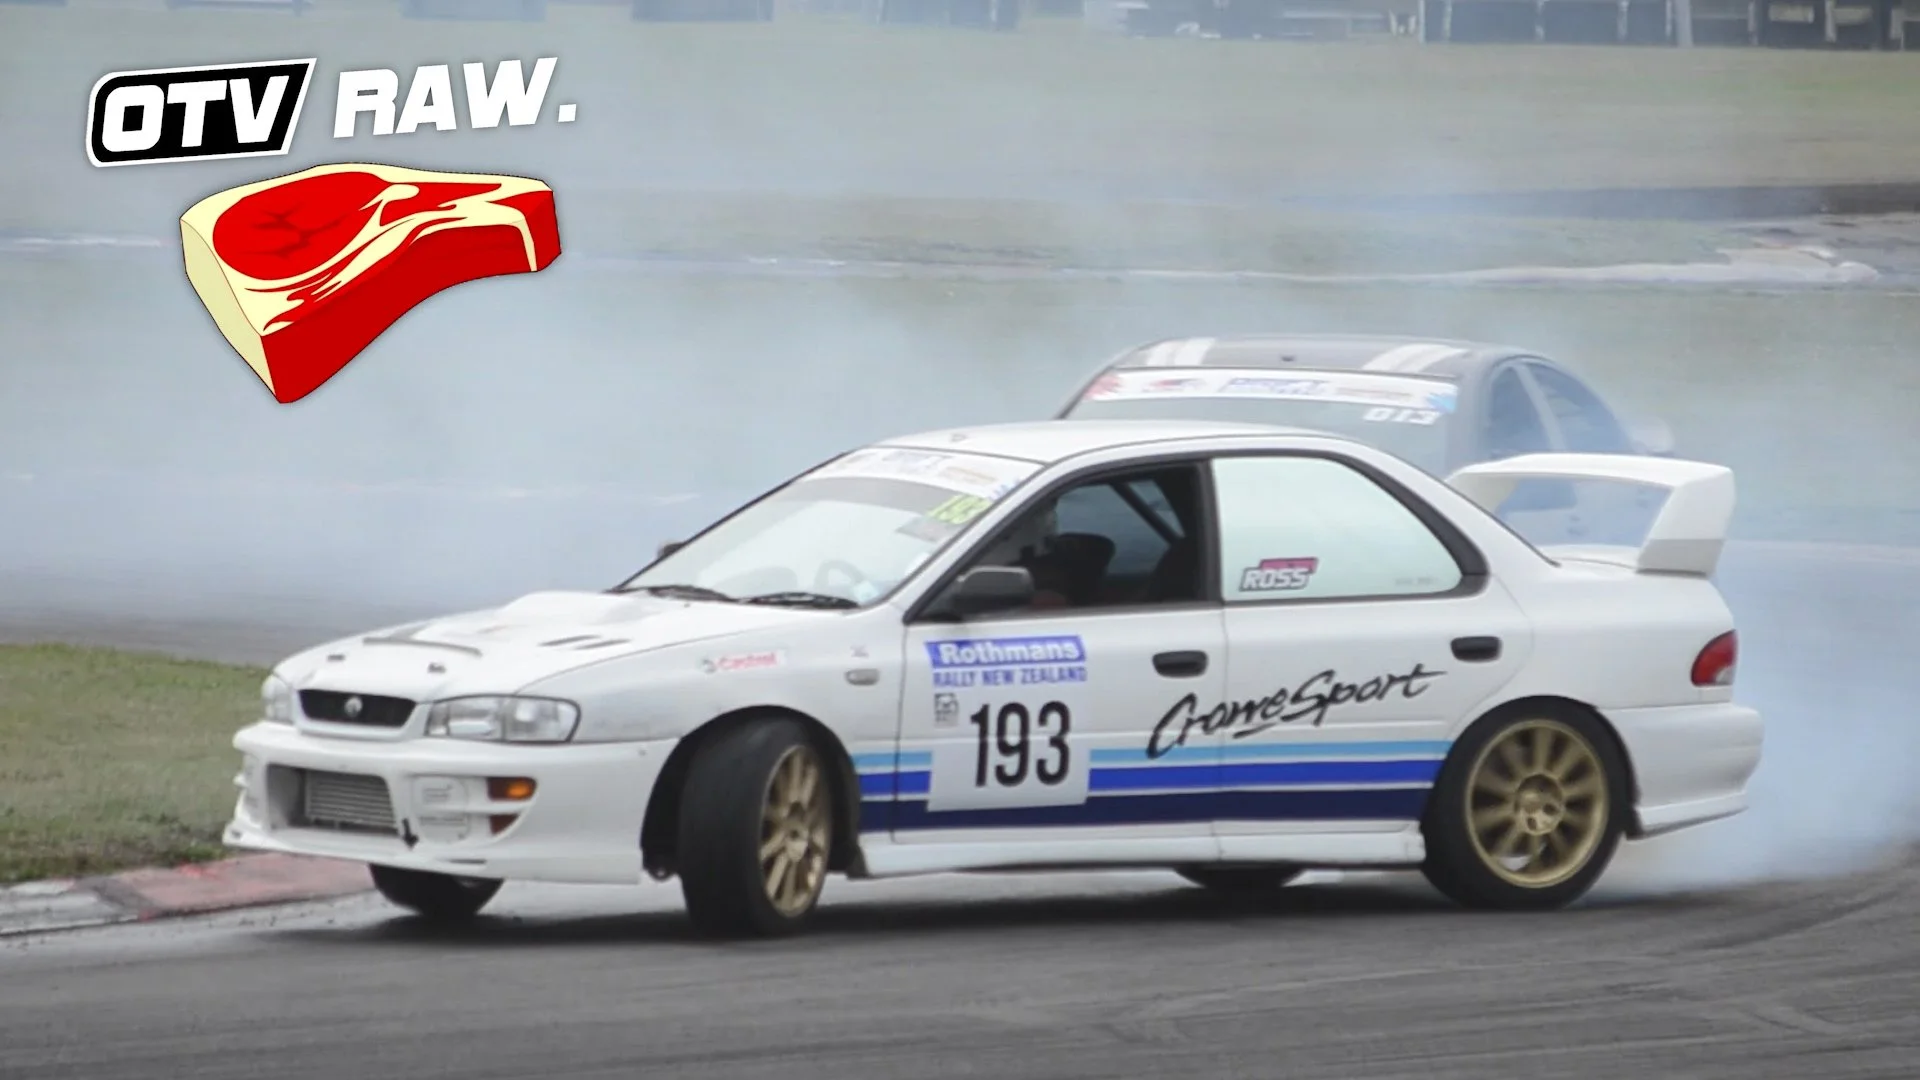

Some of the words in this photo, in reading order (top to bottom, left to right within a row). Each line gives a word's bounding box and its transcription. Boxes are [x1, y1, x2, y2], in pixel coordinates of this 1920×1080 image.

[1242, 567, 1311, 590] ROSS
[938, 640, 1081, 665] Rothmans
[933, 671, 976, 688] RALLY
[981, 669, 1015, 687] NEW
[1020, 666, 1088, 685] ZEALAND
[969, 700, 1072, 789] 193
